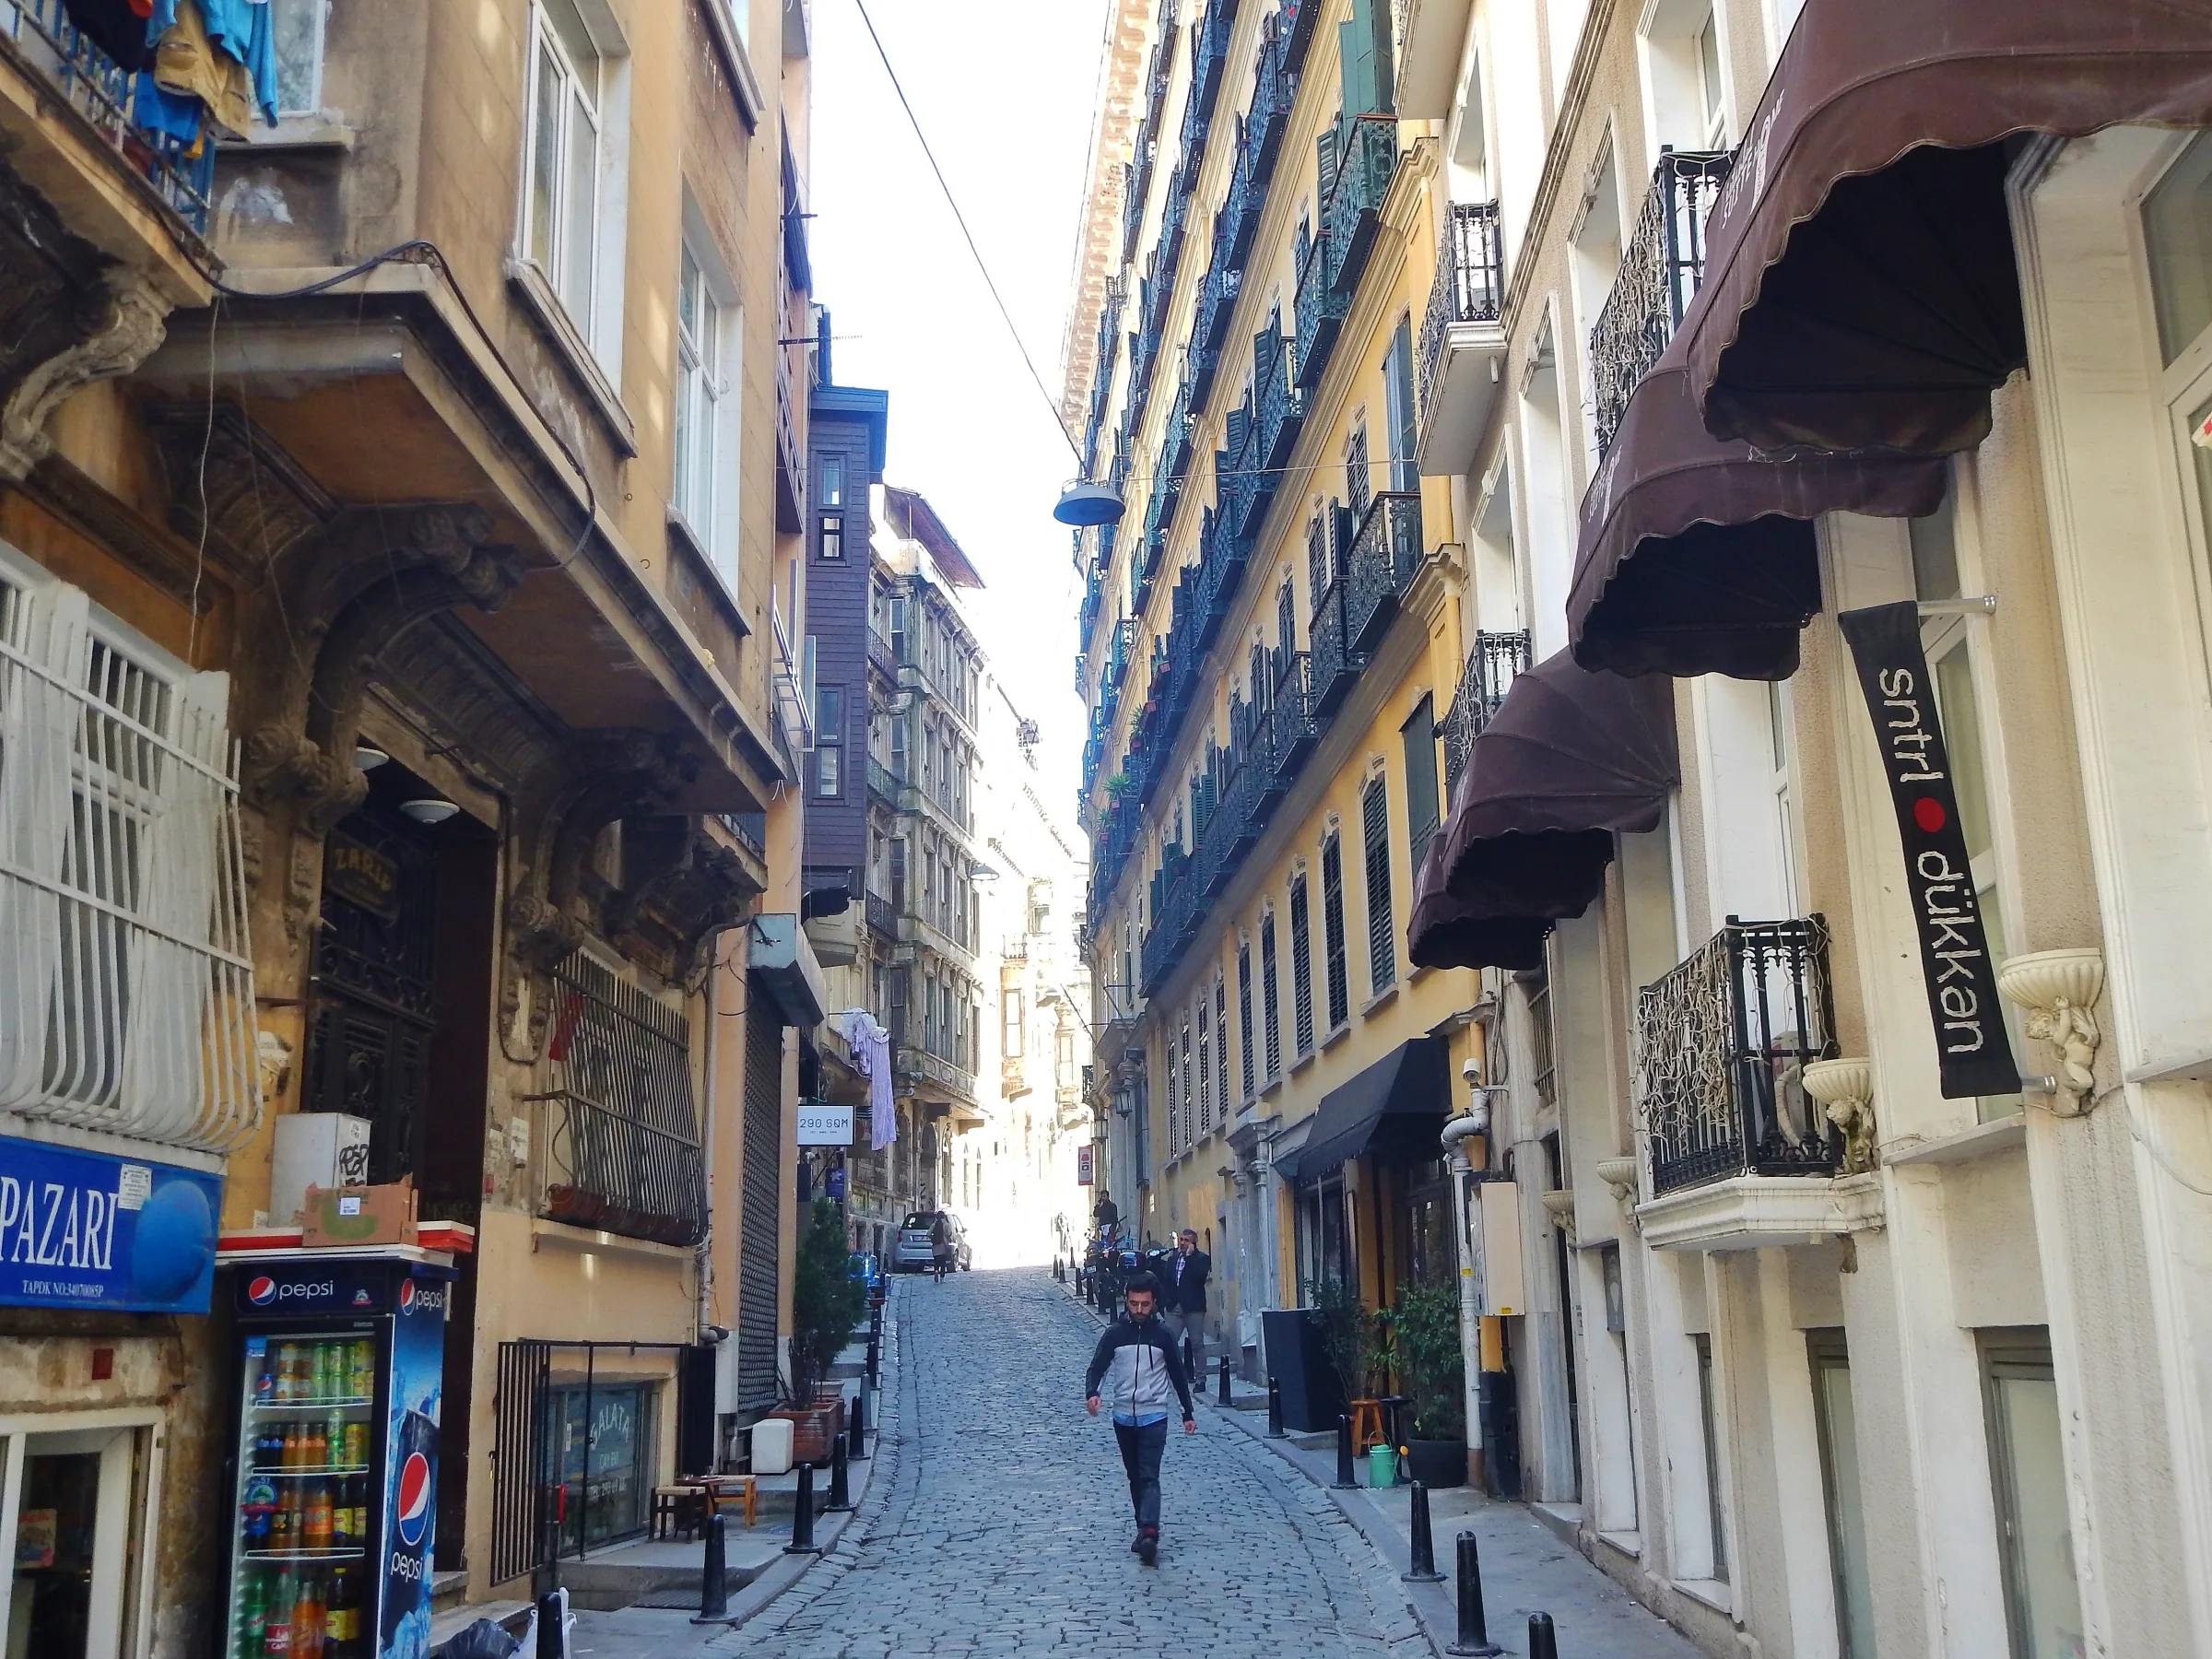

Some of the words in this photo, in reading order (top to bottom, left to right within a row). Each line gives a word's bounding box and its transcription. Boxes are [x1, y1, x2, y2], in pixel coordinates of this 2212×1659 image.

[1879, 668, 1944, 782] sntrl
[1917, 850, 1984, 1053] dükkan
[799, 1118, 822, 1128] 290
[826, 1118, 849, 1128] SQM
[0, 1176, 119, 1270] PAZARI
[278, 1280, 334, 1300] pepsi
[416, 1288, 443, 1312] pepsi
[590, 1403, 629, 1451] GALATA
[391, 1551, 424, 1583] pepsi
